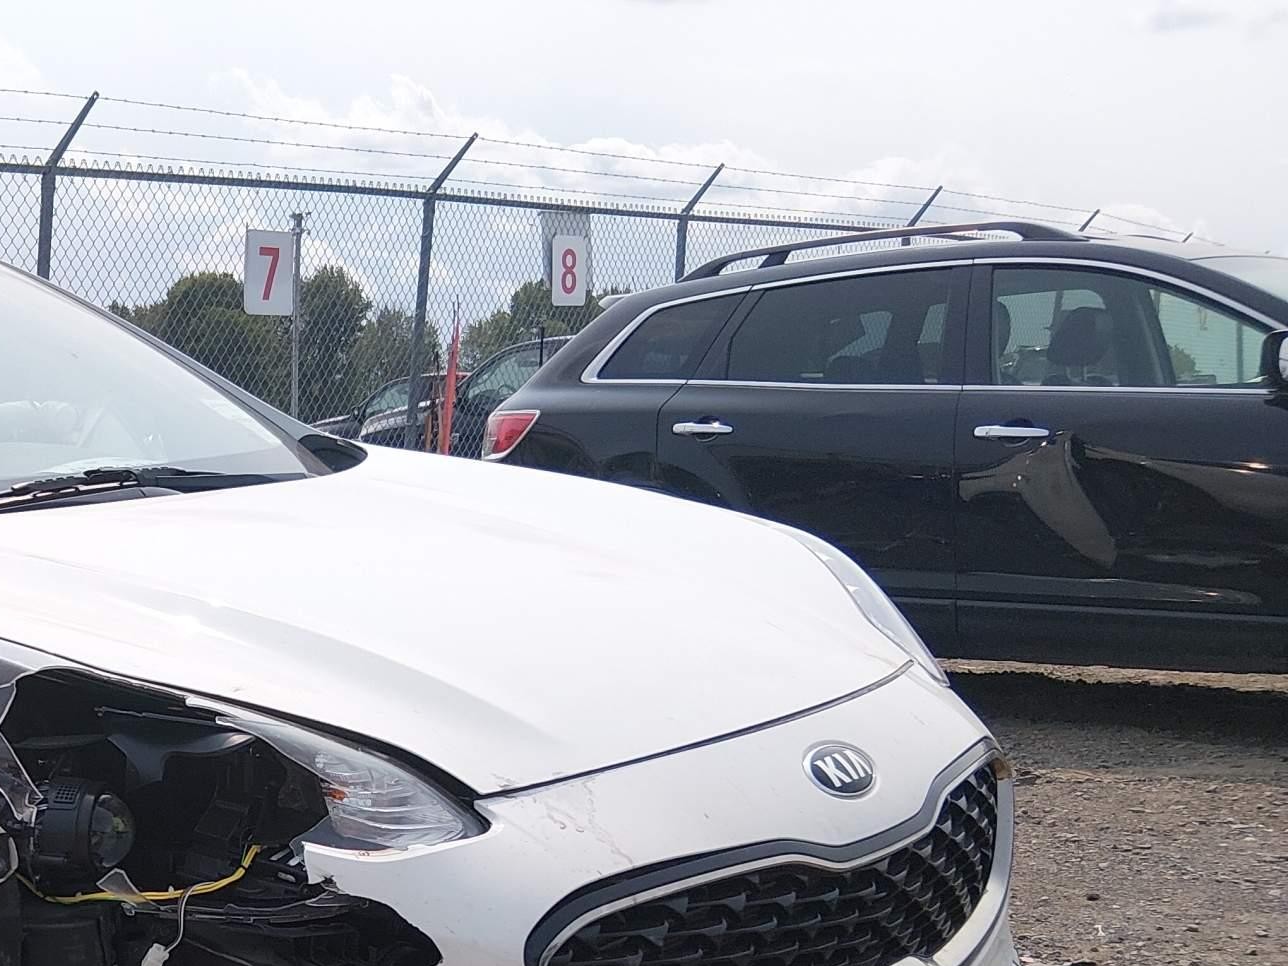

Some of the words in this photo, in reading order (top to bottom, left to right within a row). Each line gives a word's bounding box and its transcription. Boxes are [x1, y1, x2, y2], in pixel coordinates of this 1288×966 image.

[259, 246, 280, 301] 7
[561, 248, 577, 295] 8
[812, 750, 873, 788] KIA
